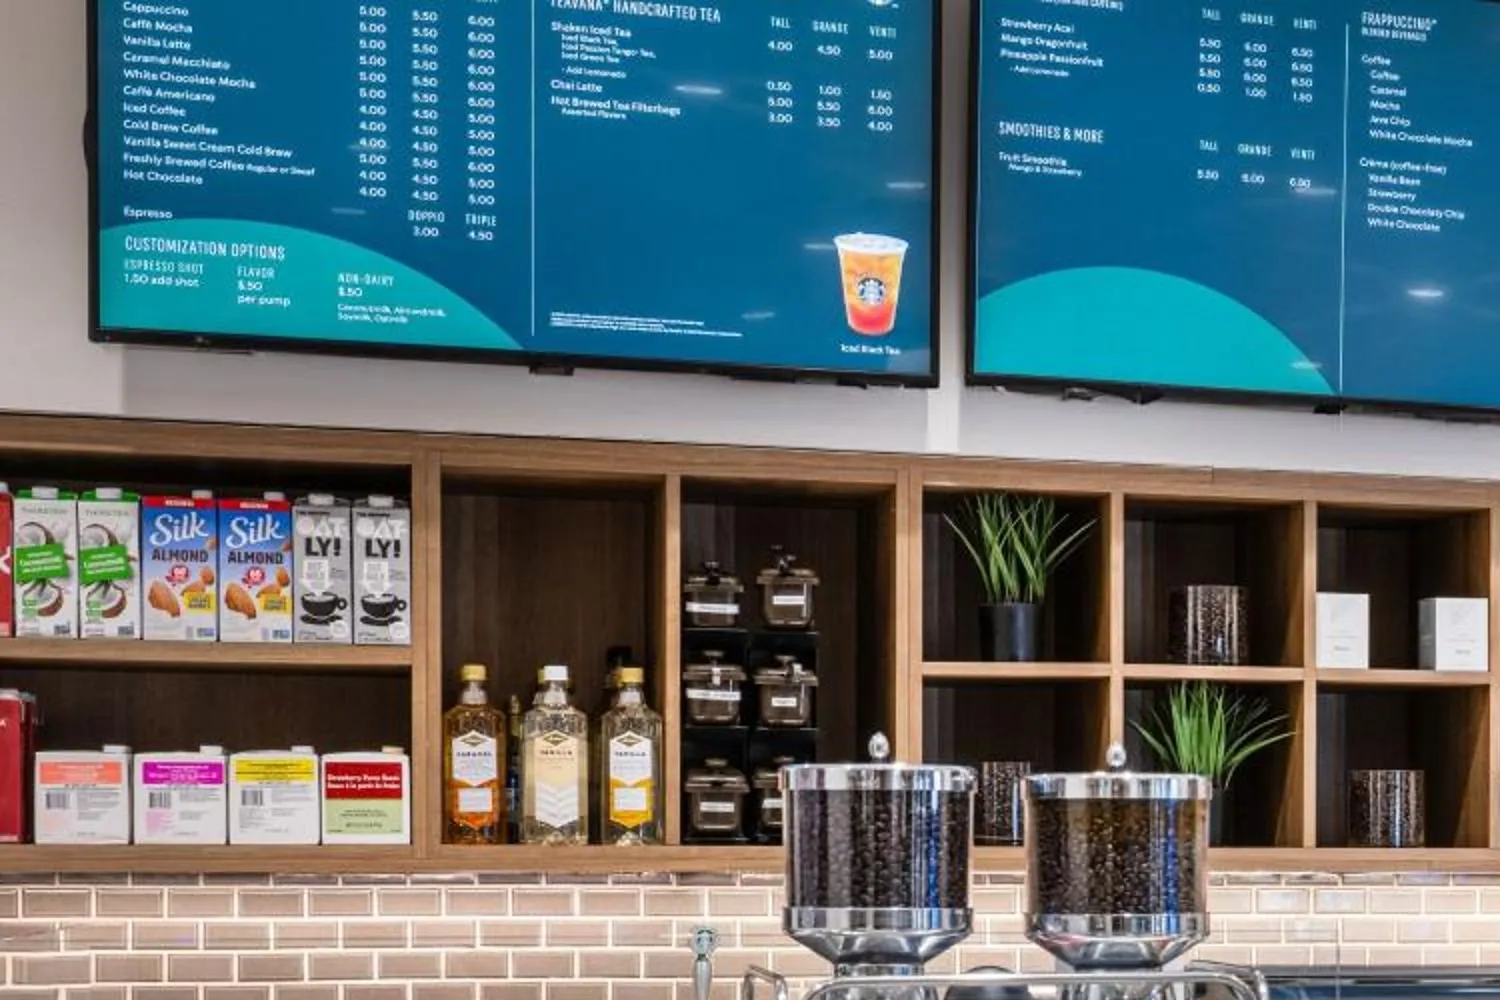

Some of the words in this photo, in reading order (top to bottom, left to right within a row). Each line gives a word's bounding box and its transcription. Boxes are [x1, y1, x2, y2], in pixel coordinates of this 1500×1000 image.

[123, 1, 188, 16] Cappuccino
[613, 0, 696, 20] HANDCRAFTED
[155, 21, 192, 33] Mocha
[124, 35, 161, 47] Vanilla
[162, 38, 190, 50] Latte
[123, 52, 170, 65] Caramel
[172, 56, 230, 70] Macchiato
[124, 69, 158, 80] White
[160, 72, 216, 85] Chocolate
[218, 77, 256, 88] Mocha
[155, 88, 215, 102] Americano
[124, 102, 147, 113] Iced
[150, 104, 186, 116] Coffee
[124, 120, 149, 130] Cold
[151, 122, 180, 132] Brew
[181, 124, 218, 134] Coffee
[1000, 121, 1060, 140] SMOOTHIES
[1074, 128, 1103, 143] MORE
[124, 136, 161, 148] Vanilla
[163, 139, 196, 150] Sweet
[198, 142, 234, 153] Cream
[238, 144, 262, 155] Cold
[264, 146, 292, 158] Brew
[124, 152, 162, 164] Freshly
[165, 156, 206, 168] Brewed
[208, 159, 245, 171] Coffee
[124, 170, 144, 180] Hot
[147, 171, 202, 184] Chocolate
[124, 206, 172, 218] Espresso
[126, 236, 226, 256] CUSTOMIZATION
[231, 243, 285, 261] OPTIONS
[150, 511, 209, 546] Silk
[225, 514, 285, 548] Silk
[305, 536, 341, 556] LY!
[365, 538, 401, 558] LY!
[151, 549, 209, 562] ALMOND
[227, 551, 283, 564] ALMOND
